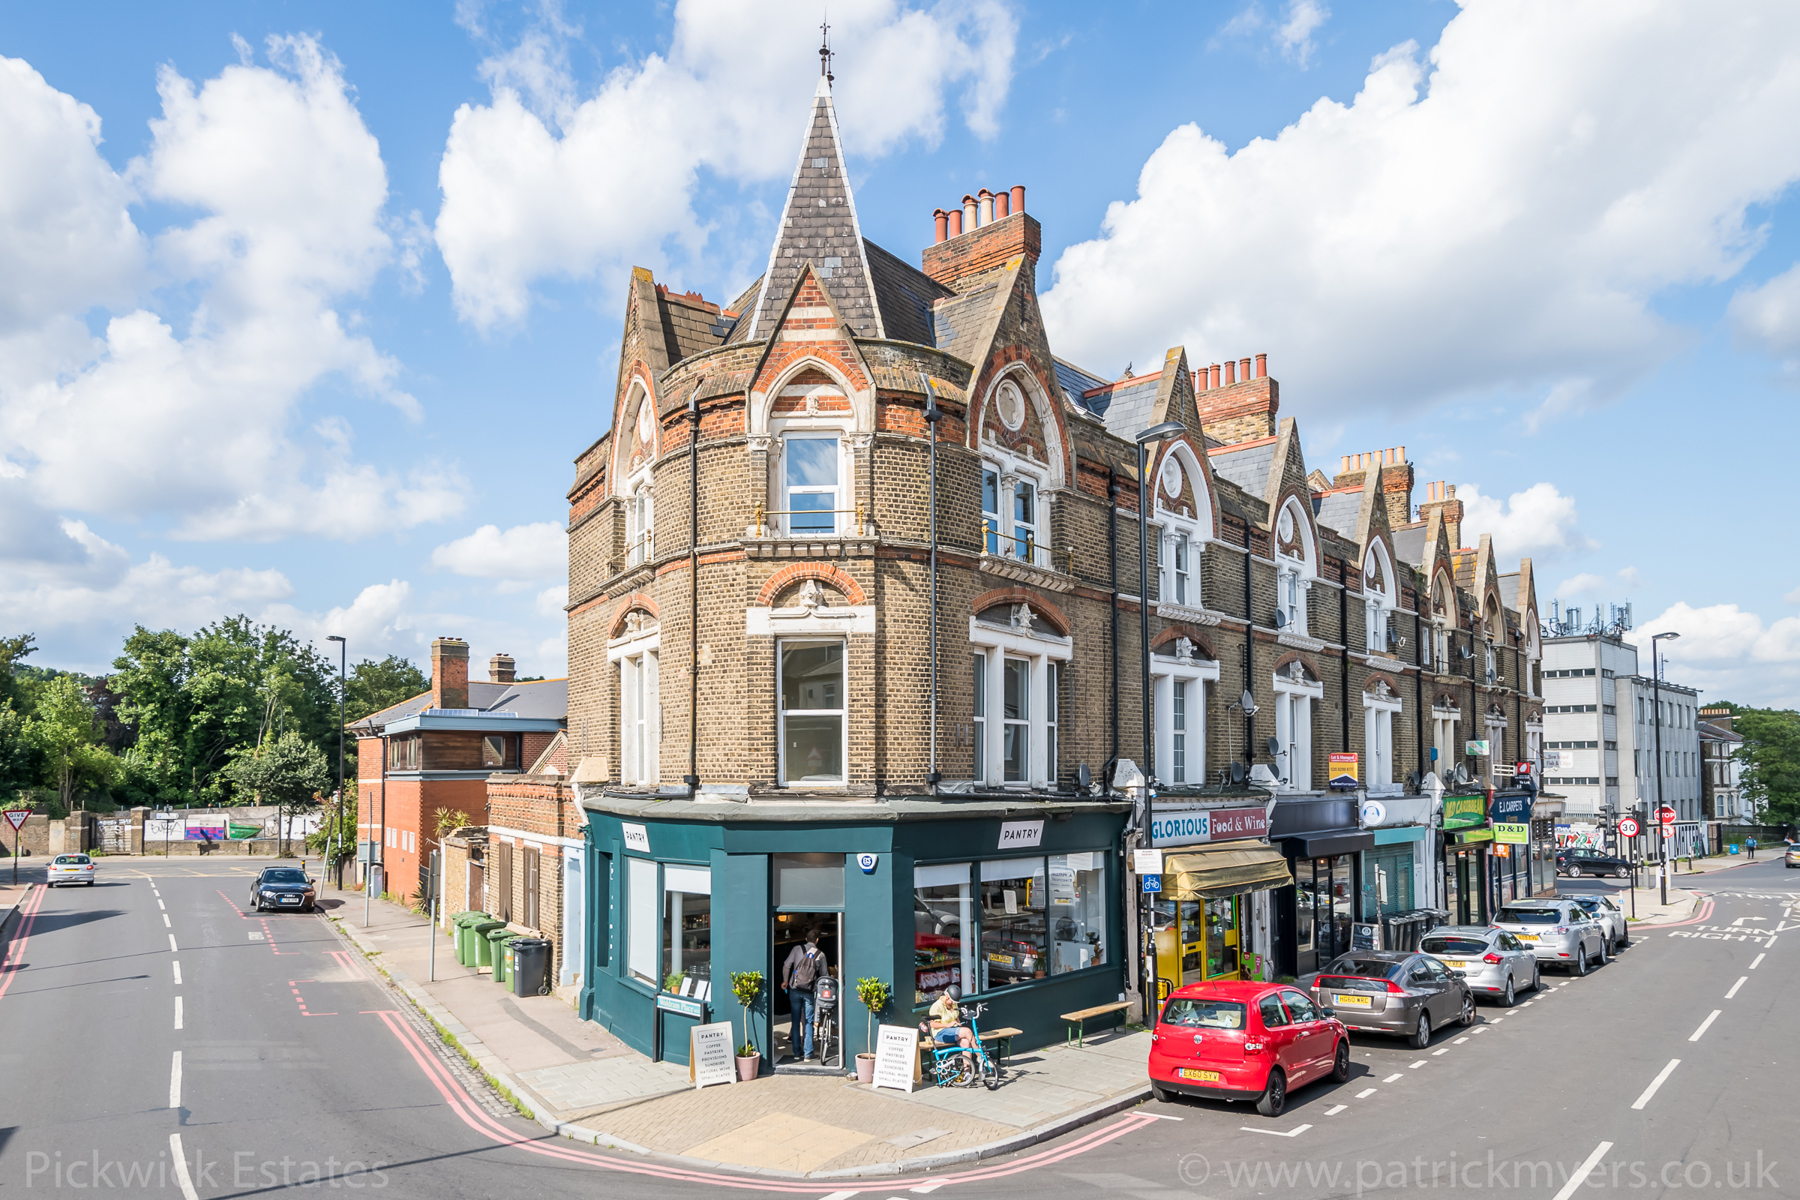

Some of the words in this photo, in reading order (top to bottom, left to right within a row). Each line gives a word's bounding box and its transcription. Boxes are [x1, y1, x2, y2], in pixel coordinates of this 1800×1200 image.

[1506, 800, 1522, 812] CARPETS
[1152, 818, 1207, 839] GLORIOUS
[1212, 818, 1233, 834] Food
[1235, 816, 1242, 831] &
[1244, 815, 1265, 830] Wine
[1622, 824, 1635, 832] 30
[626, 831, 645, 843] PANTRY
[1004, 829, 1038, 840] PANTRY
[1694, 925, 1776, 935] TURN
[1668, 931, 1770, 942] RIGHT
[681, 1002, 694, 1012] Place
[1184, 1070, 1201, 1078] EX60
